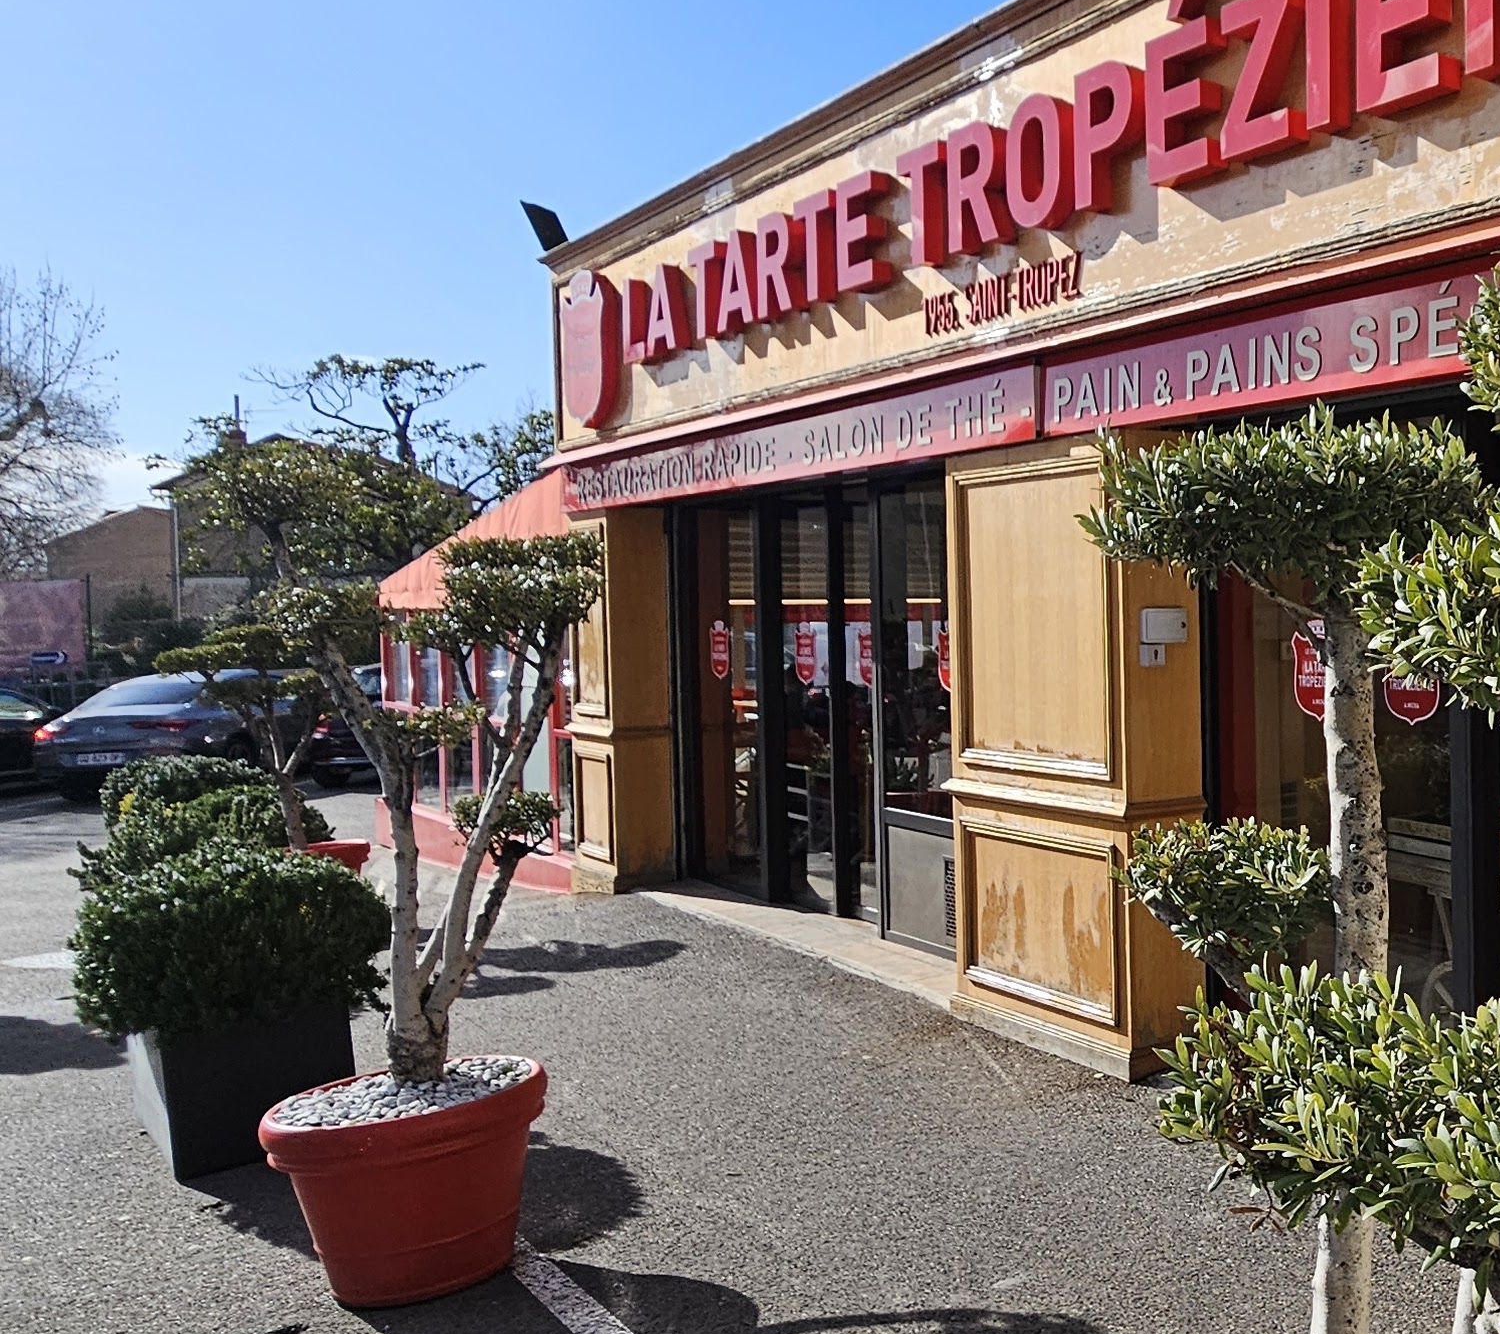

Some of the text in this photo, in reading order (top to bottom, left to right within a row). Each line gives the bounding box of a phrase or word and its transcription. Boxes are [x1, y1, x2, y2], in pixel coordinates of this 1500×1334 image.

[623, 263, 692, 366] LA
[688, 170, 892, 341] TARTE
[1053, 280, 1462, 424] PAIN & PAINS SPÉ
[576, 451, 696, 505] RESTAURATION
[703, 437, 777, 481] RAPIDE
[803, 415, 885, 466] SALON
[897, 403, 933, 450] DE
[944, 379, 1007, 441] THÉ
